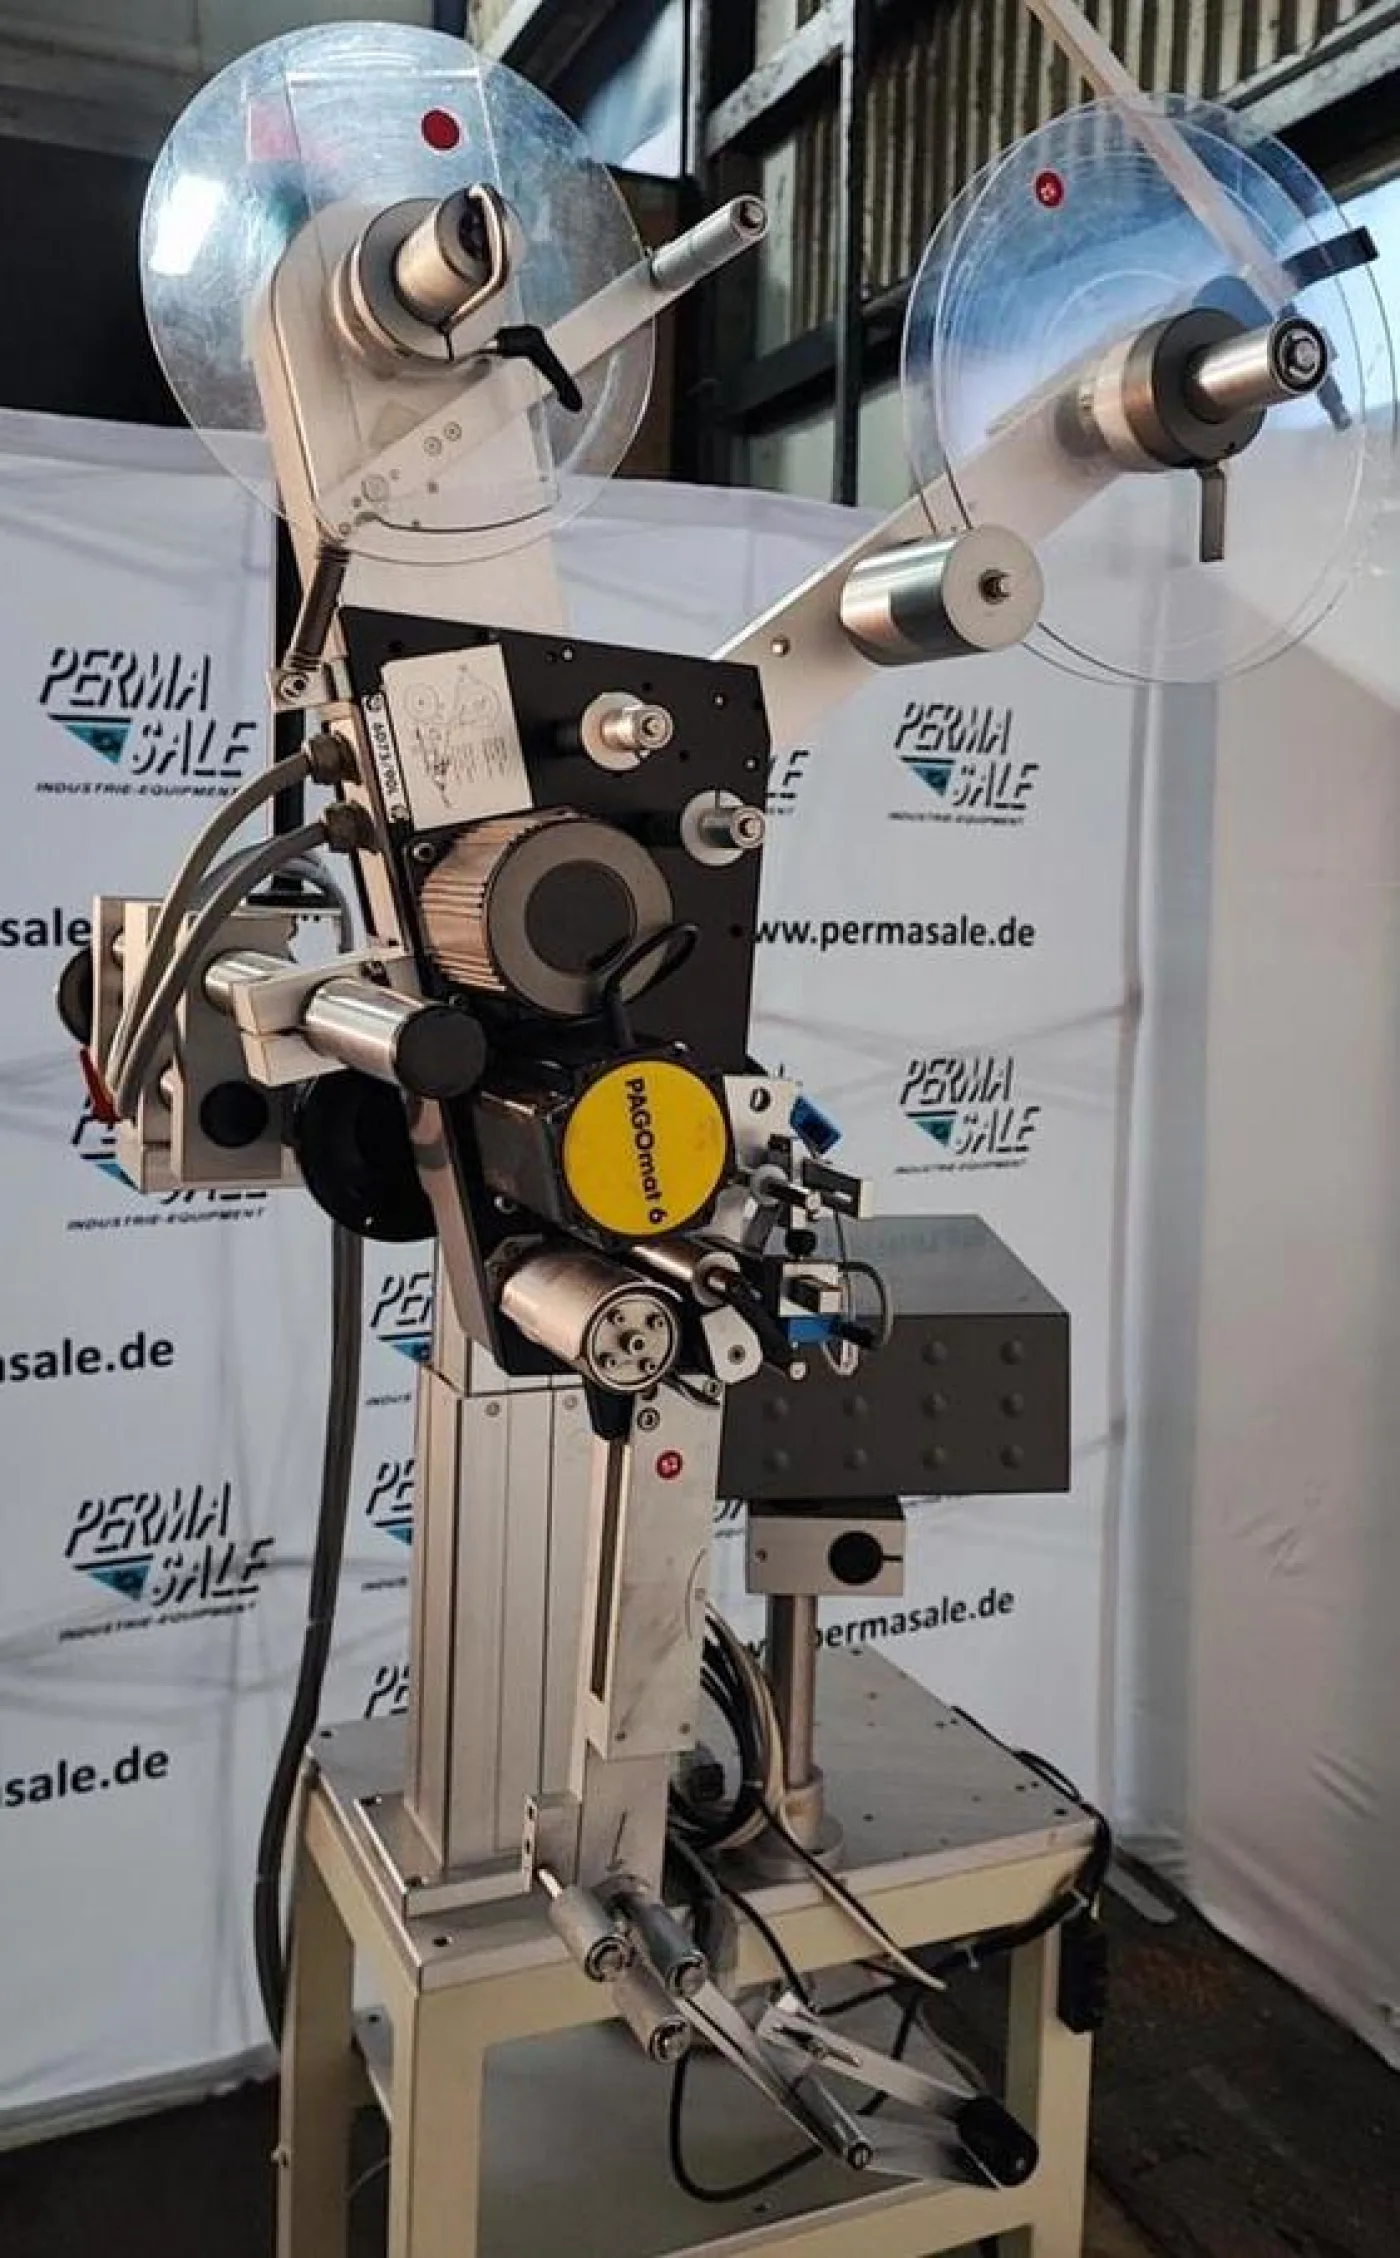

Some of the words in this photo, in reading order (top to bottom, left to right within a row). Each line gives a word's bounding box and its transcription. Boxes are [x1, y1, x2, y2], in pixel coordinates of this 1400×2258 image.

[39, 647, 210, 711] PERMA
[132, 718, 257, 777] SALE
[894, 702, 1012, 755] PERMA
[953, 762, 1039, 809] SALE
[899, 1056, 1014, 1105] PERMA
[625, 1078, 663, 1201] PAGOmat
[648, 1208, 668, 1224] 6
[956, 1106, 1041, 1154] SALE
[65, 1481, 230, 1557] PERMA
[152, 1536, 275, 1606] SALE
